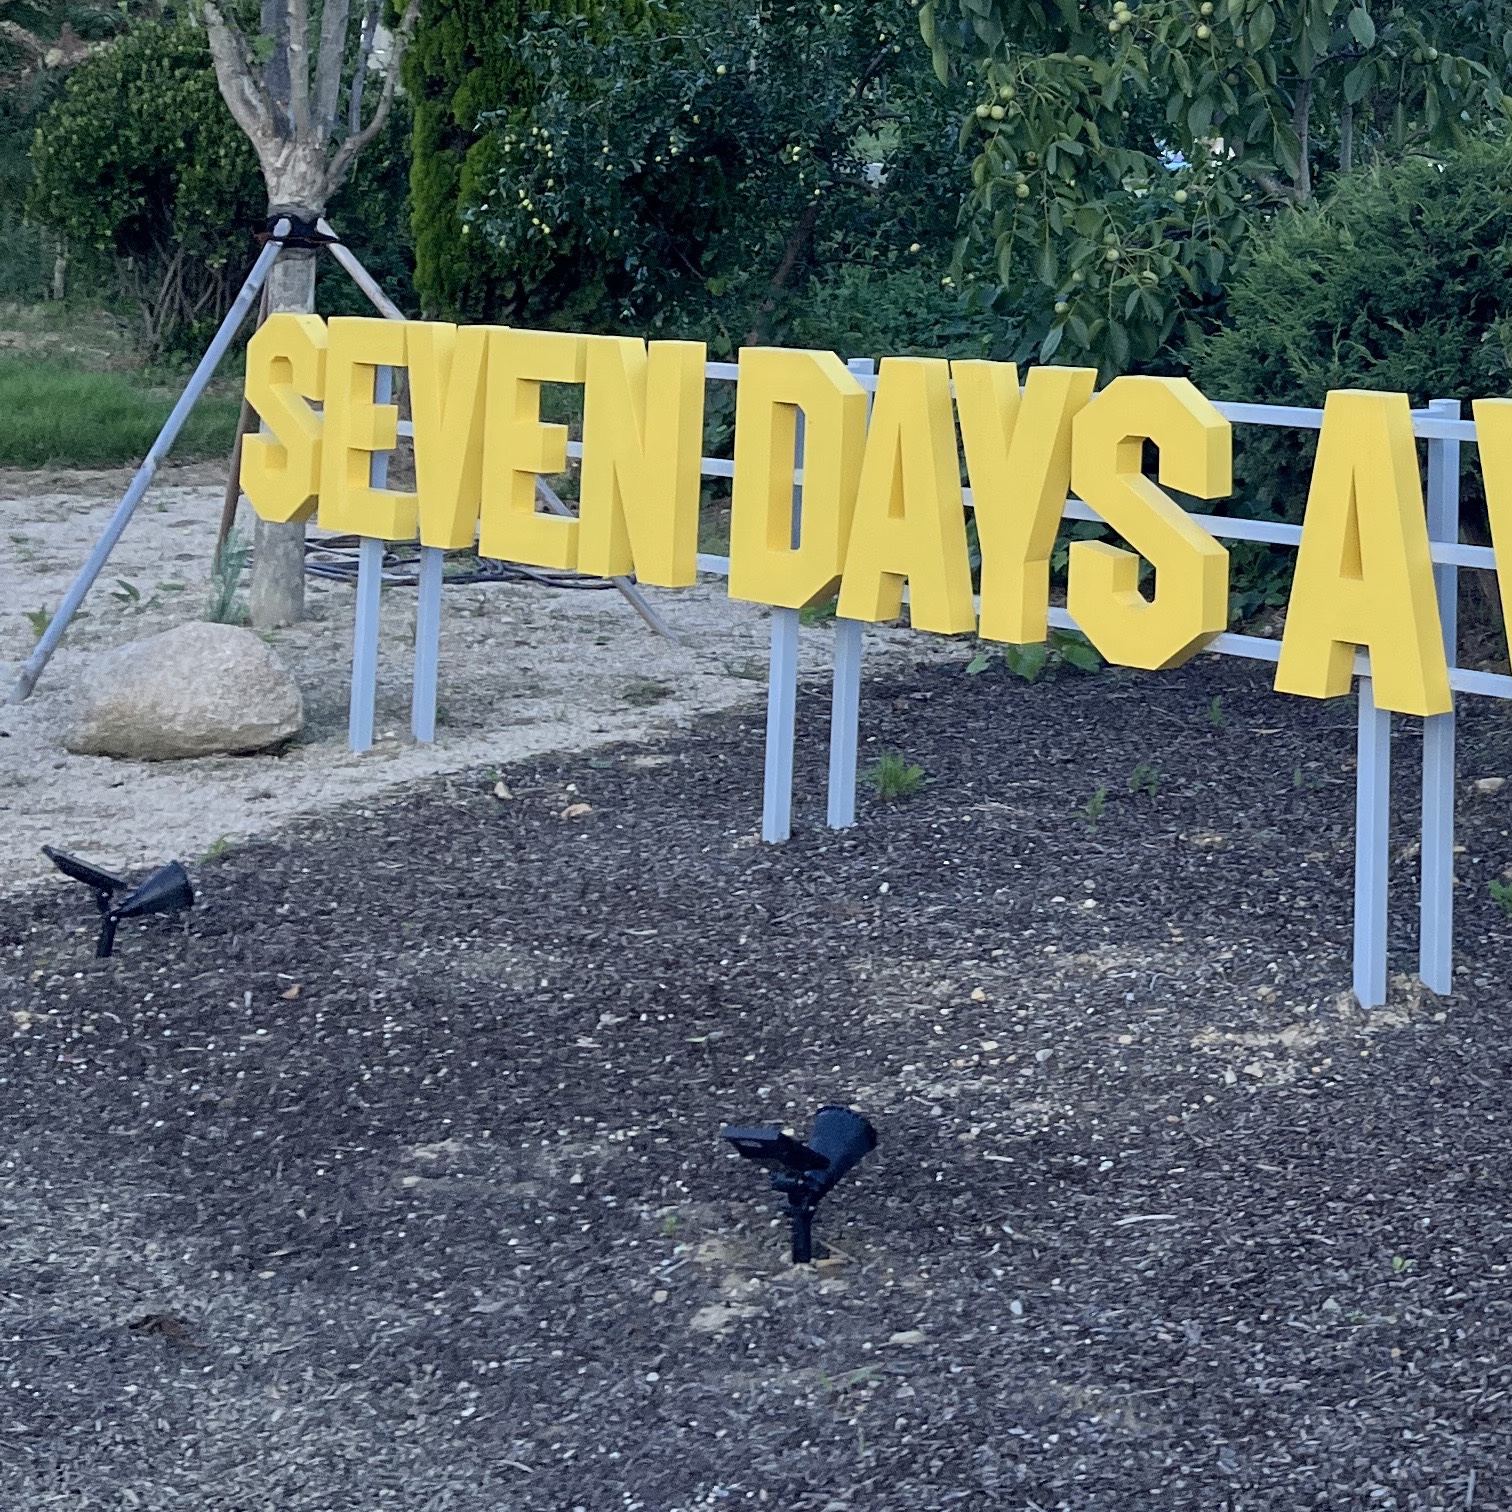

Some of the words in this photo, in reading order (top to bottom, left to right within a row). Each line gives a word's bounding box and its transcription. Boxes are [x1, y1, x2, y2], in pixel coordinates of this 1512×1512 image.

[239, 313, 707, 588] SEVEN
[728, 347, 1232, 670] DAYS
[1273, 389, 1453, 717] A
